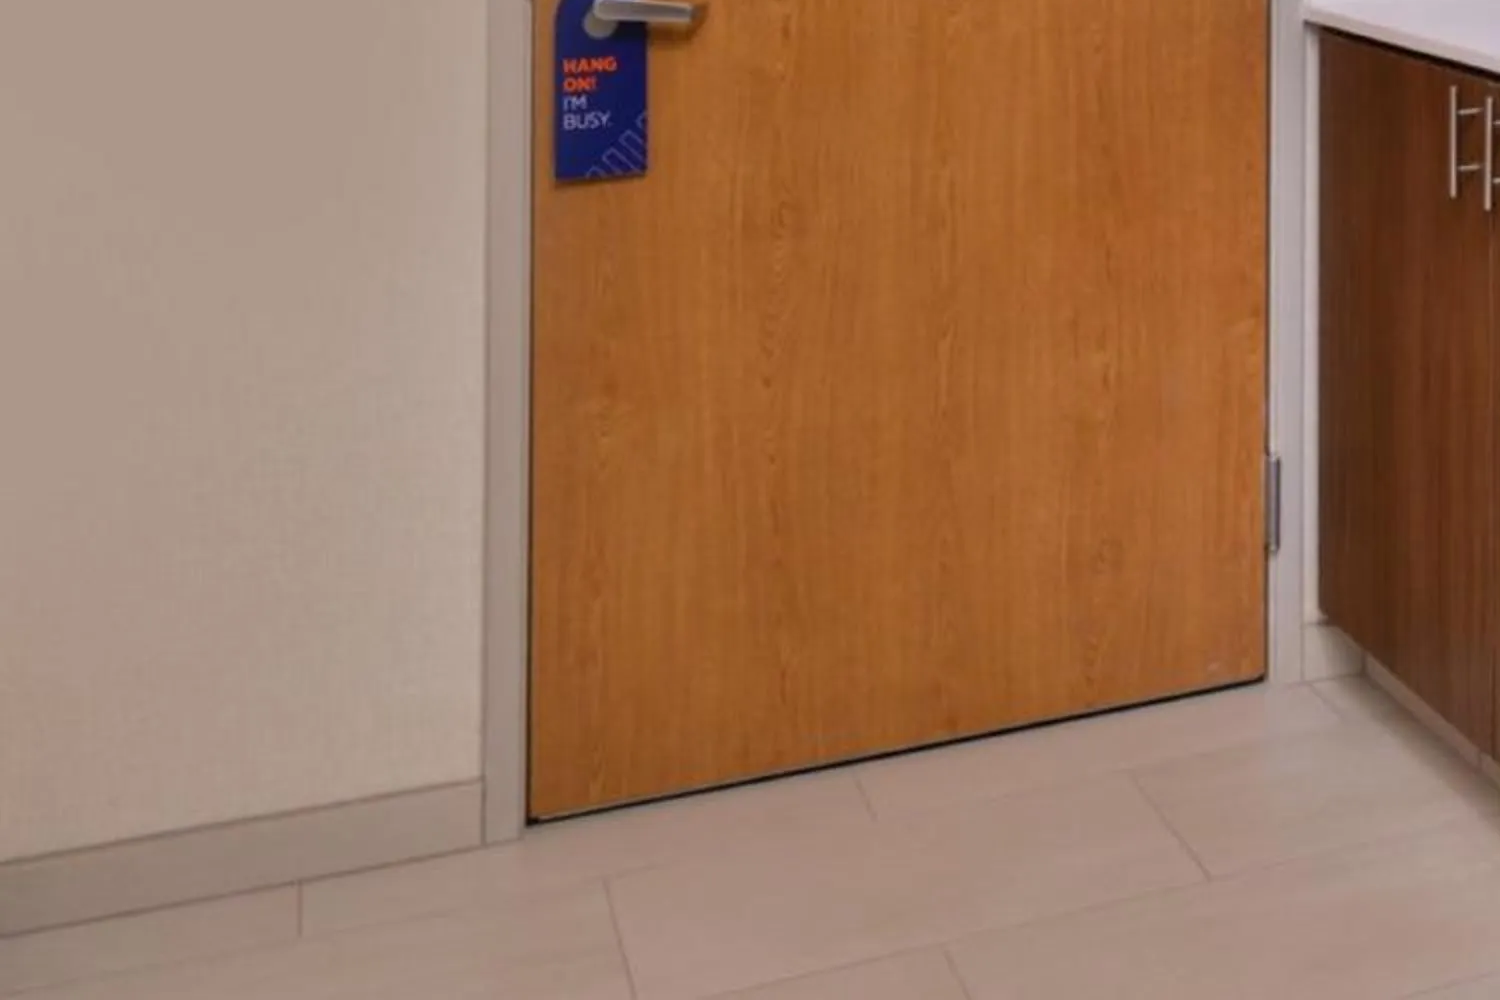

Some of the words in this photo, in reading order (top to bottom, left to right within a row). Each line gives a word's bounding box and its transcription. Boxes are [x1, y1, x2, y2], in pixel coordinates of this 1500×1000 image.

[562, 56, 618, 74] HANG
[563, 75, 597, 92] ON!
[563, 94, 587, 111] I'M
